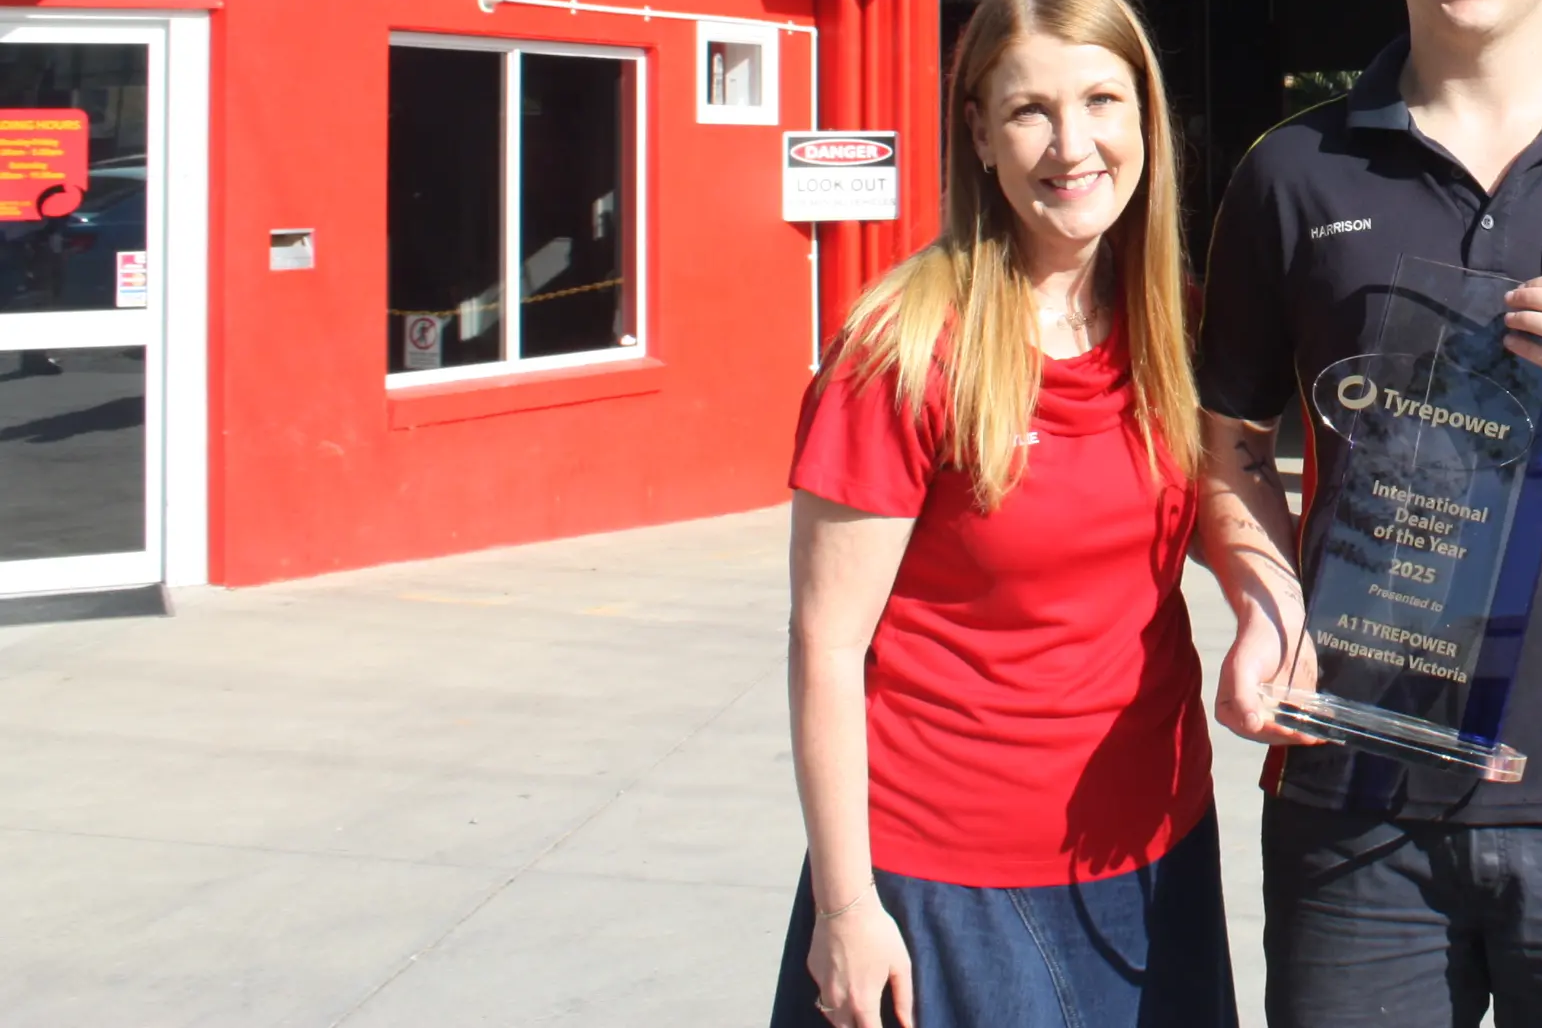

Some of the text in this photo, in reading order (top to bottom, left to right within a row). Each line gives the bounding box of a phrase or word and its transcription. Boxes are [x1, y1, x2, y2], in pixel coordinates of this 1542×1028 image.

[804, 145, 878, 160] DANGER
[797, 178, 886, 192] LOOK OUT
[1310, 218, 1373, 240] HARRISON
[1382, 387, 1511, 441] Tyrepower
[1372, 480, 1489, 524] International
[1394, 508, 1454, 536] Dealer
[1373, 525, 1467, 560] of the Year
[1388, 559, 1436, 584] 2025
[1368, 584, 1444, 612] Presented to
[1337, 614, 1458, 658] A1 TYREPOWER
[1316, 630, 1467, 684] Wangaratta Victoria
